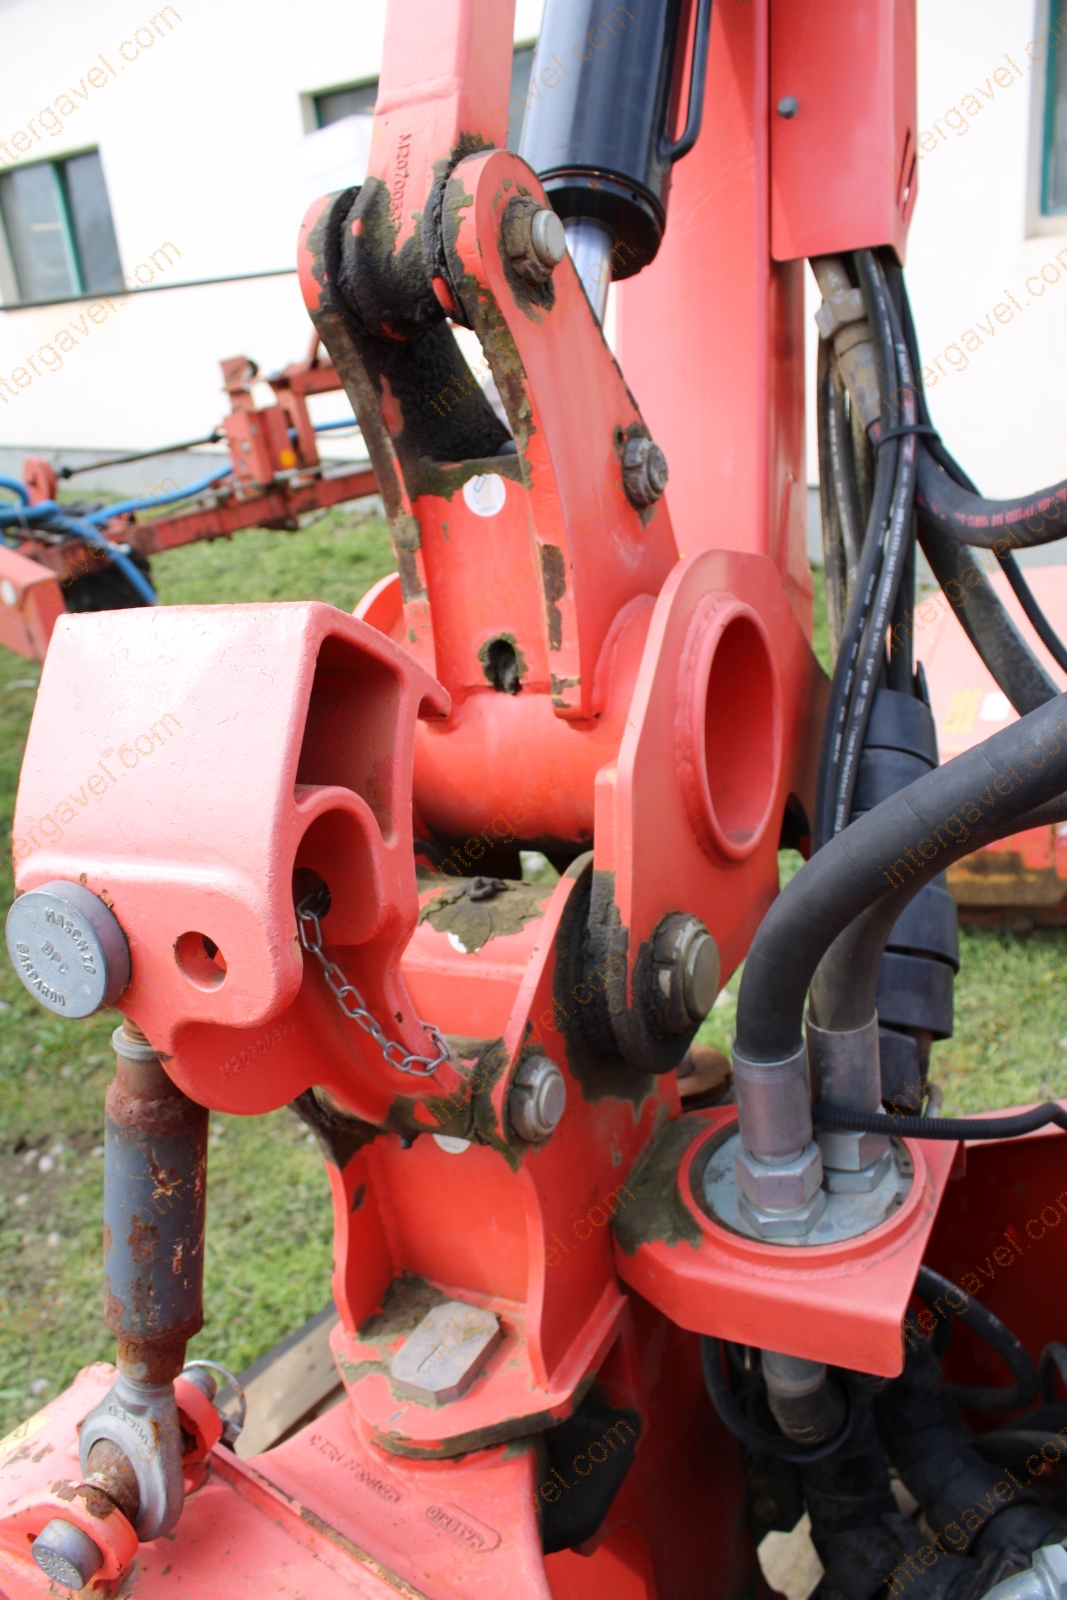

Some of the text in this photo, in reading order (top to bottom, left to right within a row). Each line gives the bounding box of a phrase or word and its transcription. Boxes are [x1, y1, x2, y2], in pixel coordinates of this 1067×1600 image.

[16, 941, 66, 1007] GASPARDO
[41, 939, 70, 975] DPC
[44, 907, 96, 975] MASCHIO
